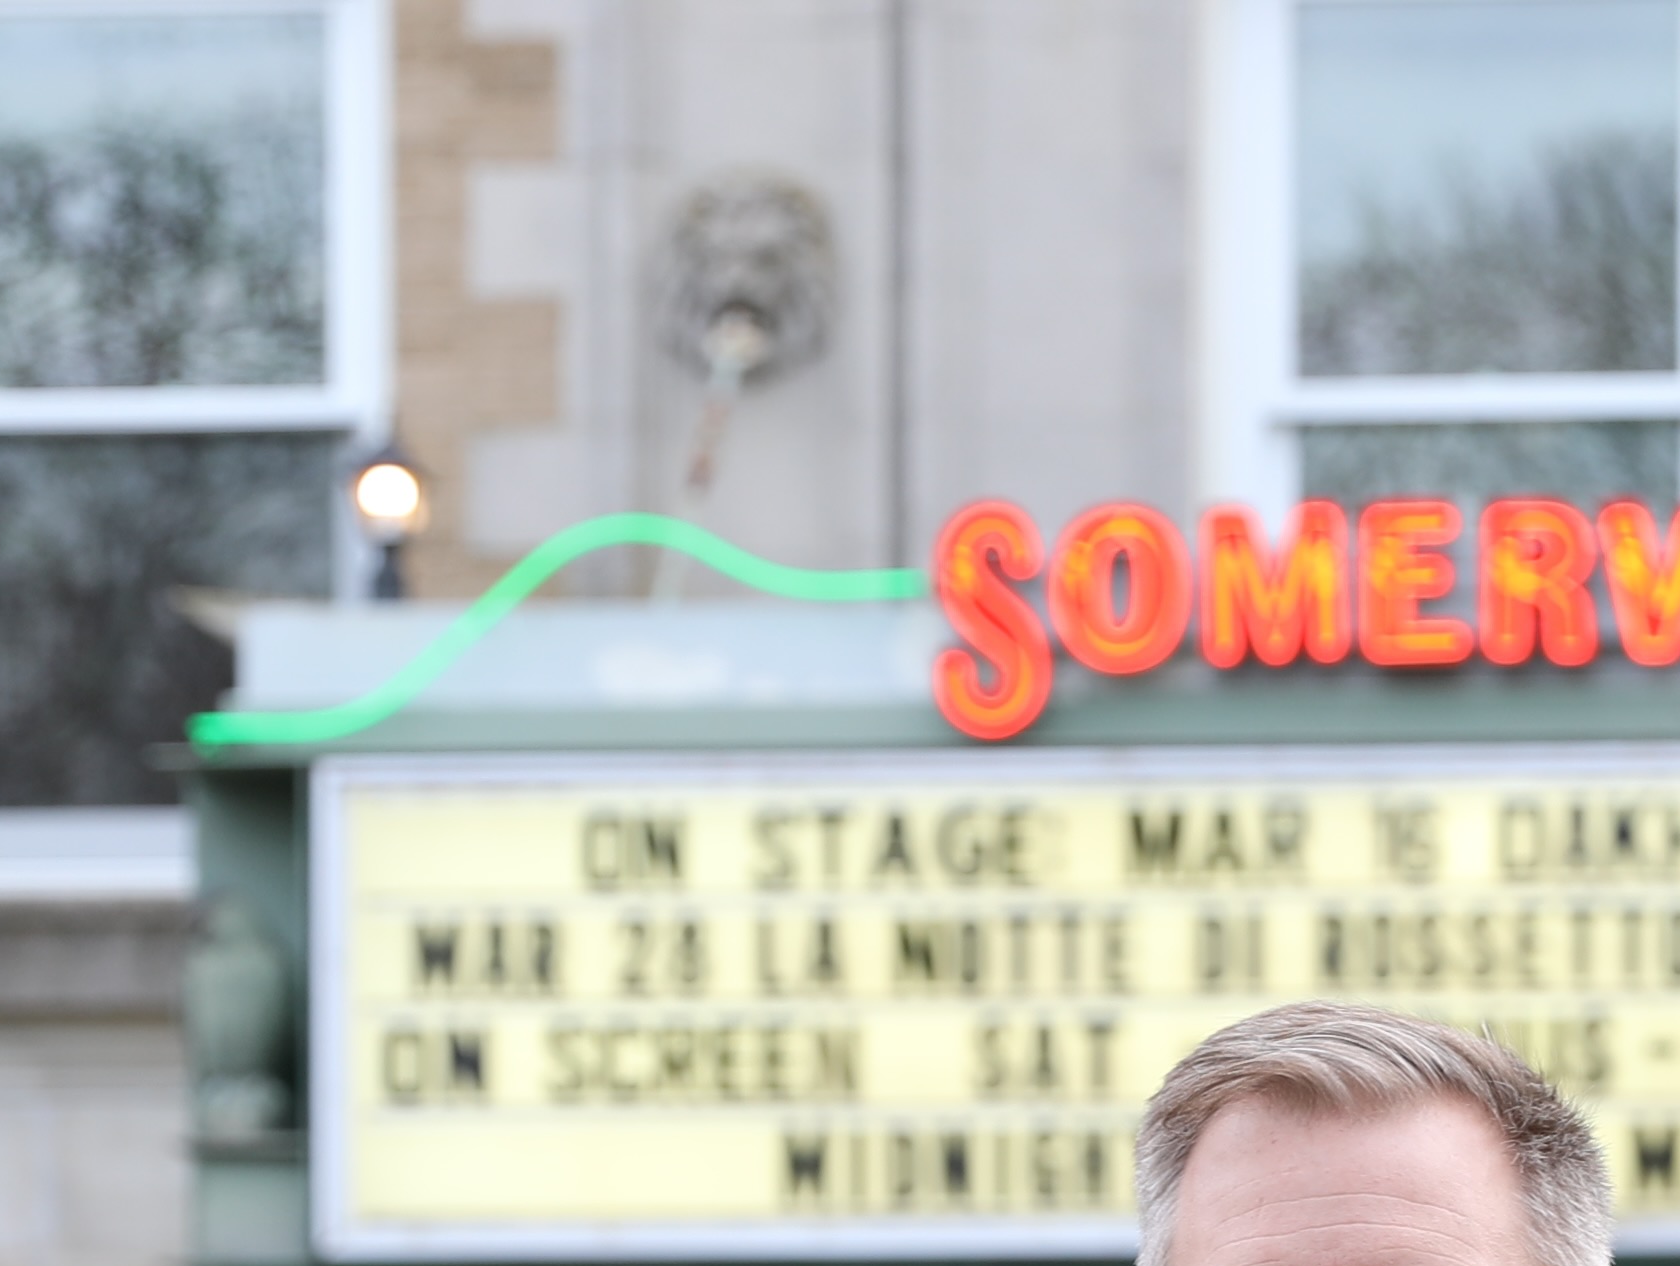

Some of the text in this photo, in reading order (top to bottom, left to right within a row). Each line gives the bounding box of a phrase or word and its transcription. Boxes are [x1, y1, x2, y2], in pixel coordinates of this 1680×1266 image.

[578, 806, 688, 892] ON
[1127, 798, 1313, 884] MAR
[410, 908, 566, 994] MAR
[754, 908, 848, 992] LA
[891, 904, 1134, 992] NOTTE
[1190, 900, 1266, 990] DI
[380, 1012, 492, 1106] ON
[542, 1012, 866, 1106] SCREEN
[968, 1010, 1126, 1104] SAT
[776, 1122, 1136, 1212] MIDNIGH
